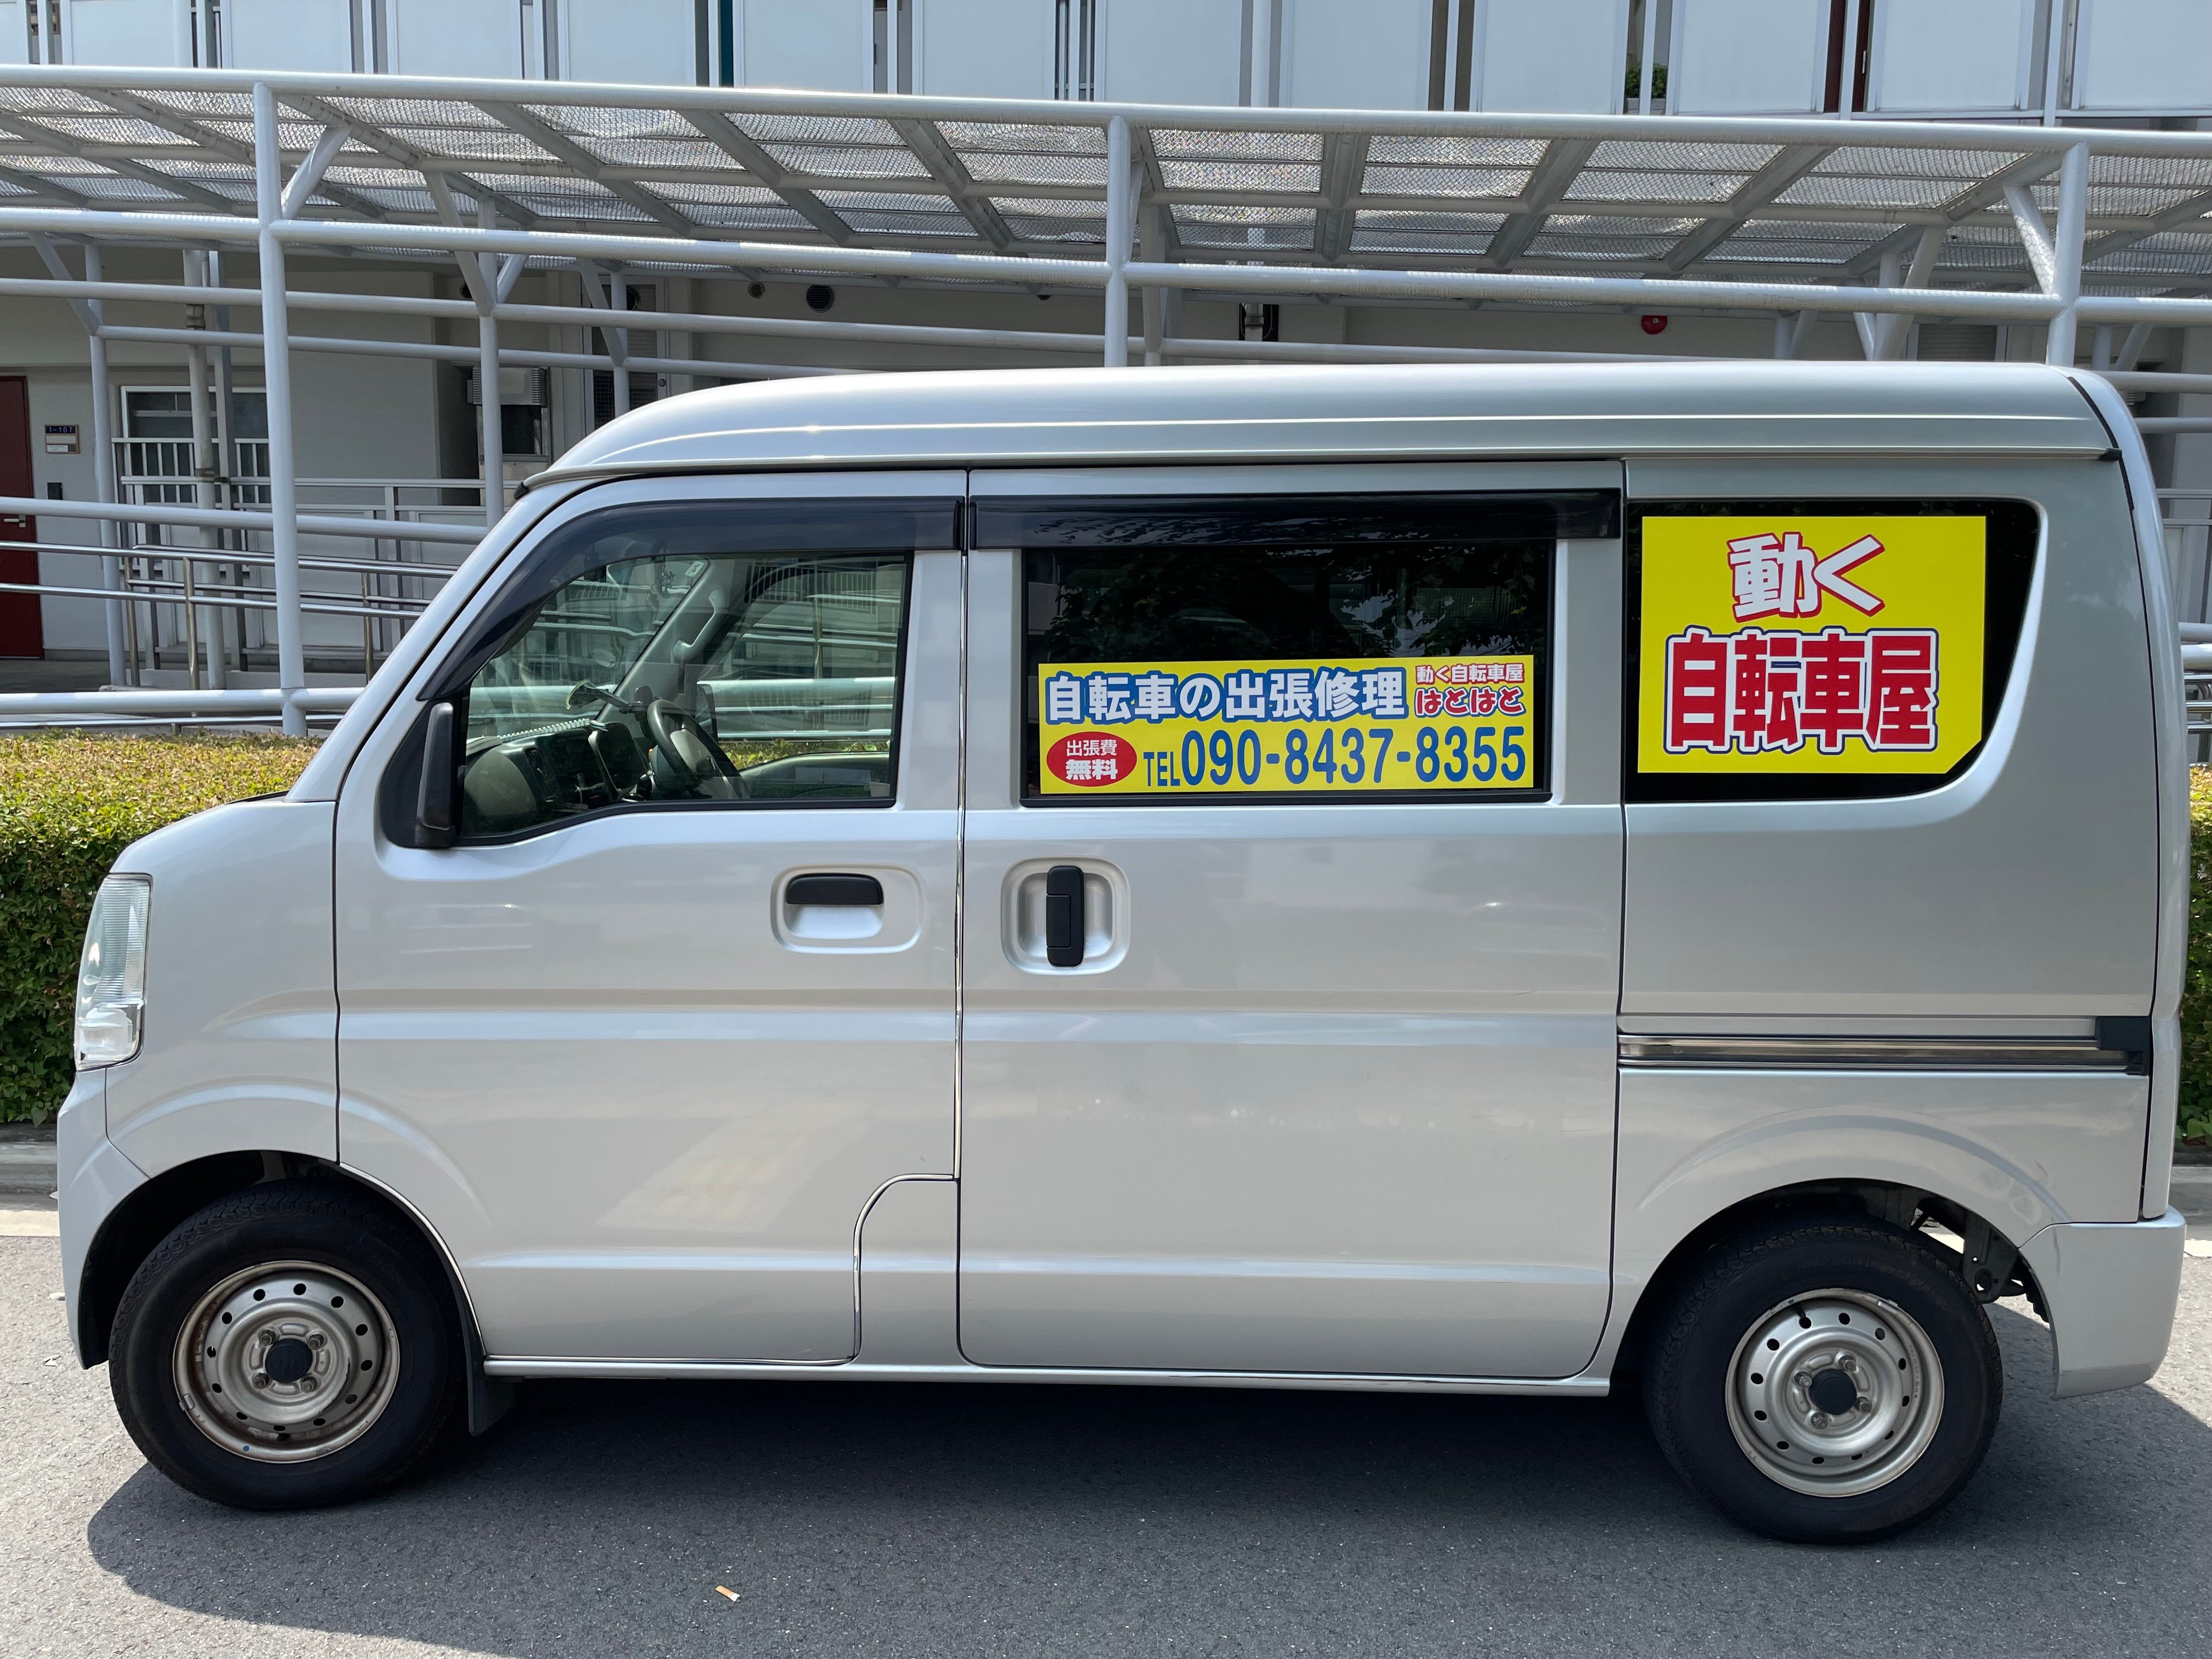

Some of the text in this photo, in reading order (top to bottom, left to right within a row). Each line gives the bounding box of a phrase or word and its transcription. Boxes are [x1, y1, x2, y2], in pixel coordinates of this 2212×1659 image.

[1726, 532, 1885, 622] 動く
[1415, 663, 1525, 684] 動く自転車屋
[1046, 667, 1408, 725] 自転車の出張修理
[1414, 685, 1527, 717] はとはと
[1664, 625, 1939, 755] 自転車屋
[1065, 739, 1118, 757] 出張費
[1065, 759, 1119, 781] 無料
